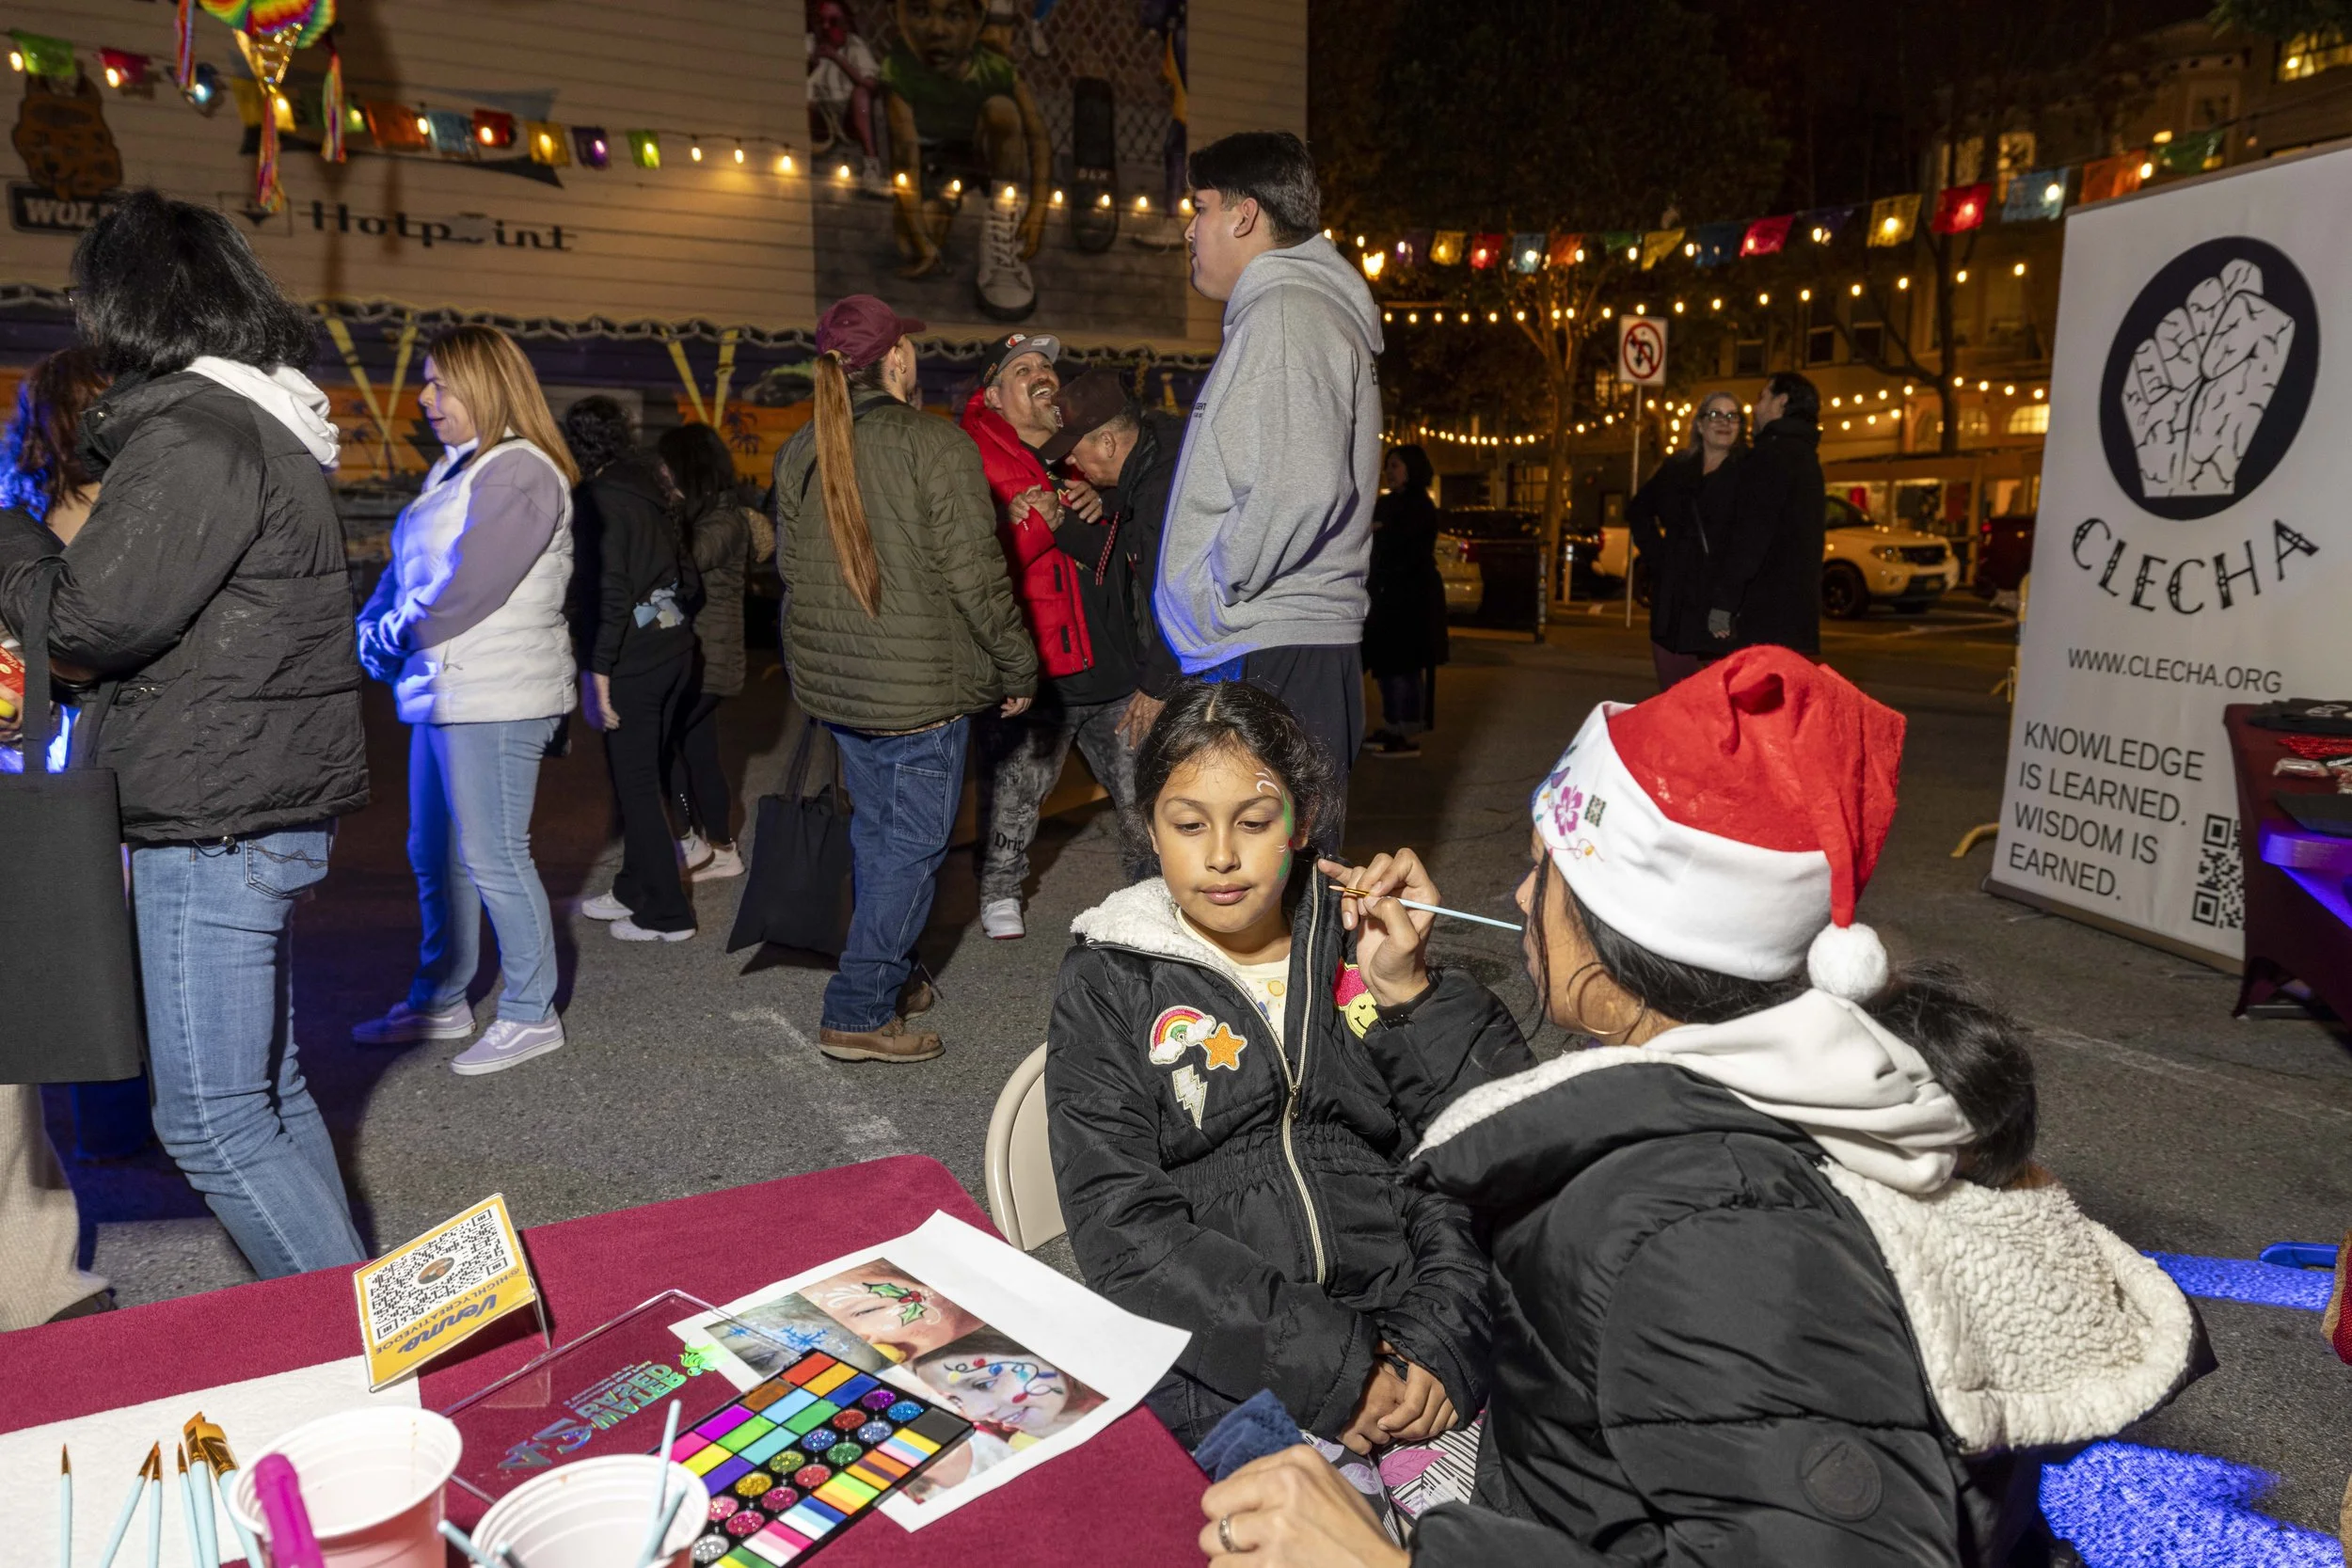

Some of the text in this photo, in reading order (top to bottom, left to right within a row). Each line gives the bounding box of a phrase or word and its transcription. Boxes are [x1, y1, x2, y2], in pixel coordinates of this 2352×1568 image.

[297, 199, 579, 253] Hotpint
[2072, 517, 2320, 615] CLECHA
[2068, 647, 2282, 694] WWW.CLECHA.ORG
[2024, 721, 2205, 783] KNOWLEDGE
[2019, 761, 2186, 826] IS LEARNED.
[2015, 801, 2159, 865] WISDOM IS
[2009, 842, 2122, 902] EARNED.
[375, 1267, 520, 1355] @HIGHLYCREATIVEDOE
[397, 1293, 498, 1354] Venmo
